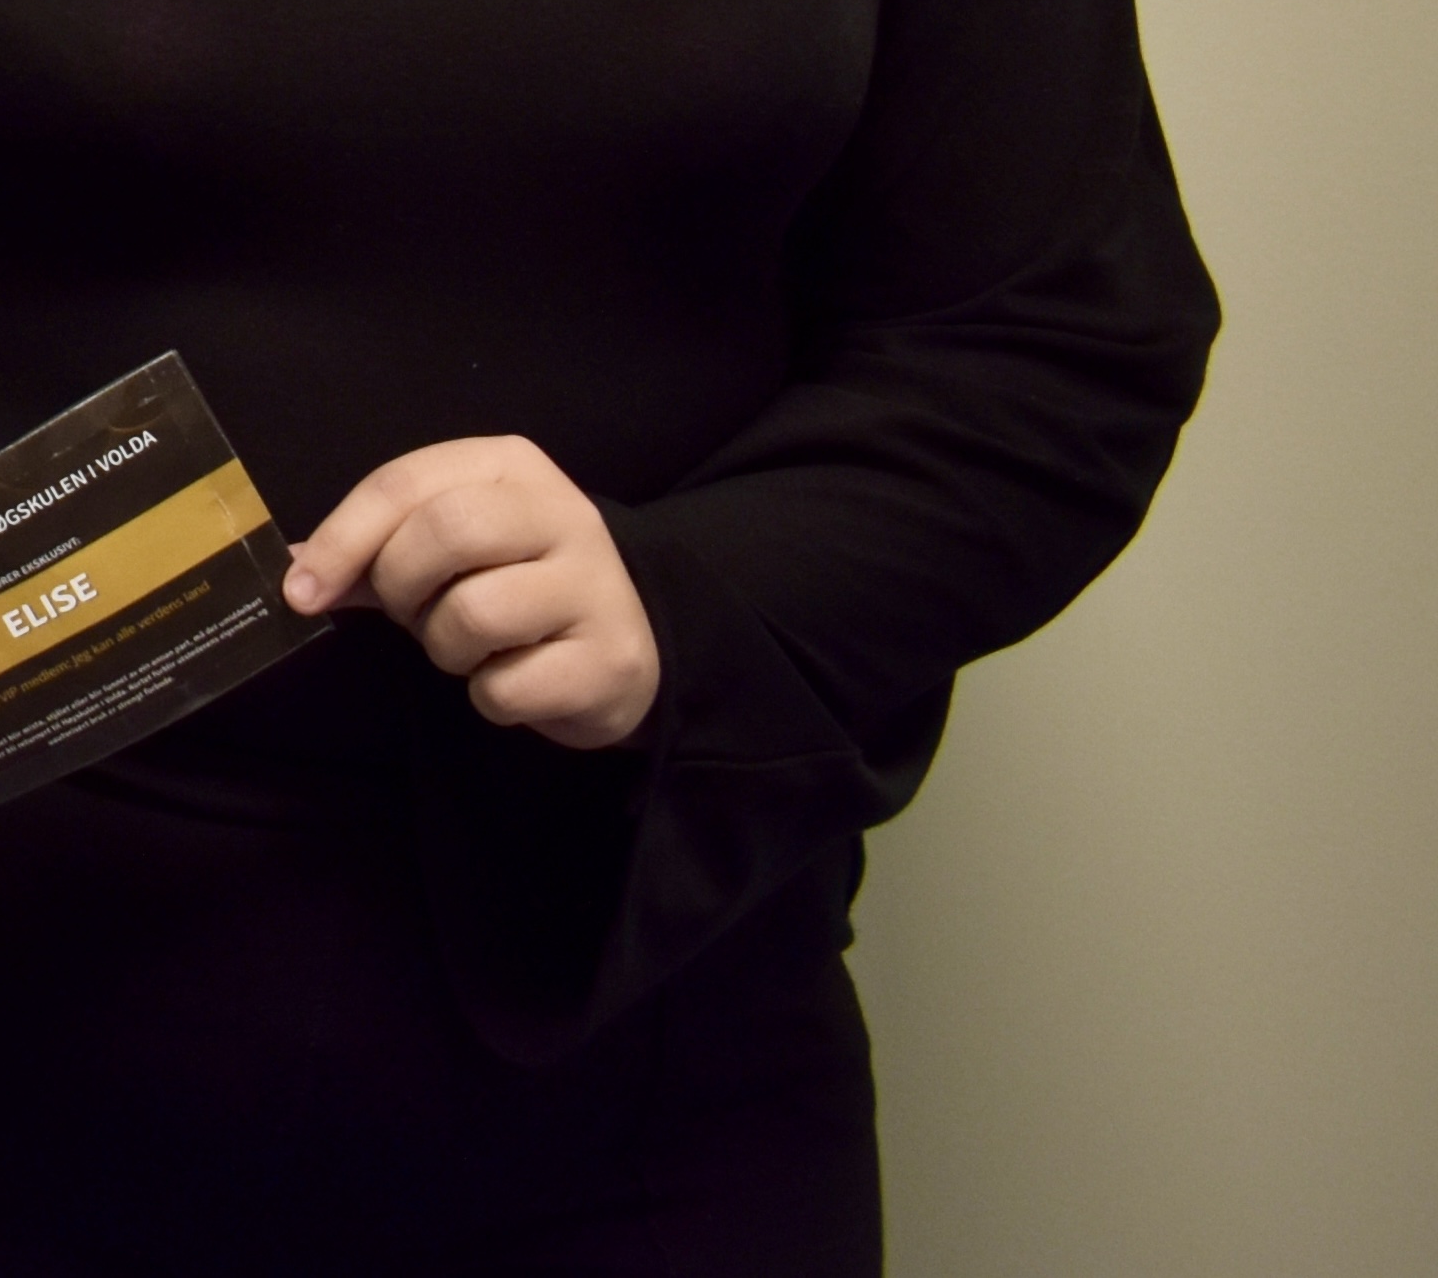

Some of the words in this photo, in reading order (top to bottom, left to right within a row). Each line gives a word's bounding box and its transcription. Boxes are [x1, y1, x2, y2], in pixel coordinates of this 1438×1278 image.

[86, 463, 97, 479] I
[94, 430, 158, 472] VOLDA
[20, 536, 81, 575] EKSKLUSIVT:
[2, 572, 97, 638] ELISE
[90, 637, 115, 655] kan
[116, 624, 137, 642] alle
[137, 598, 184, 629] verdens
[182, 579, 211, 602] land
